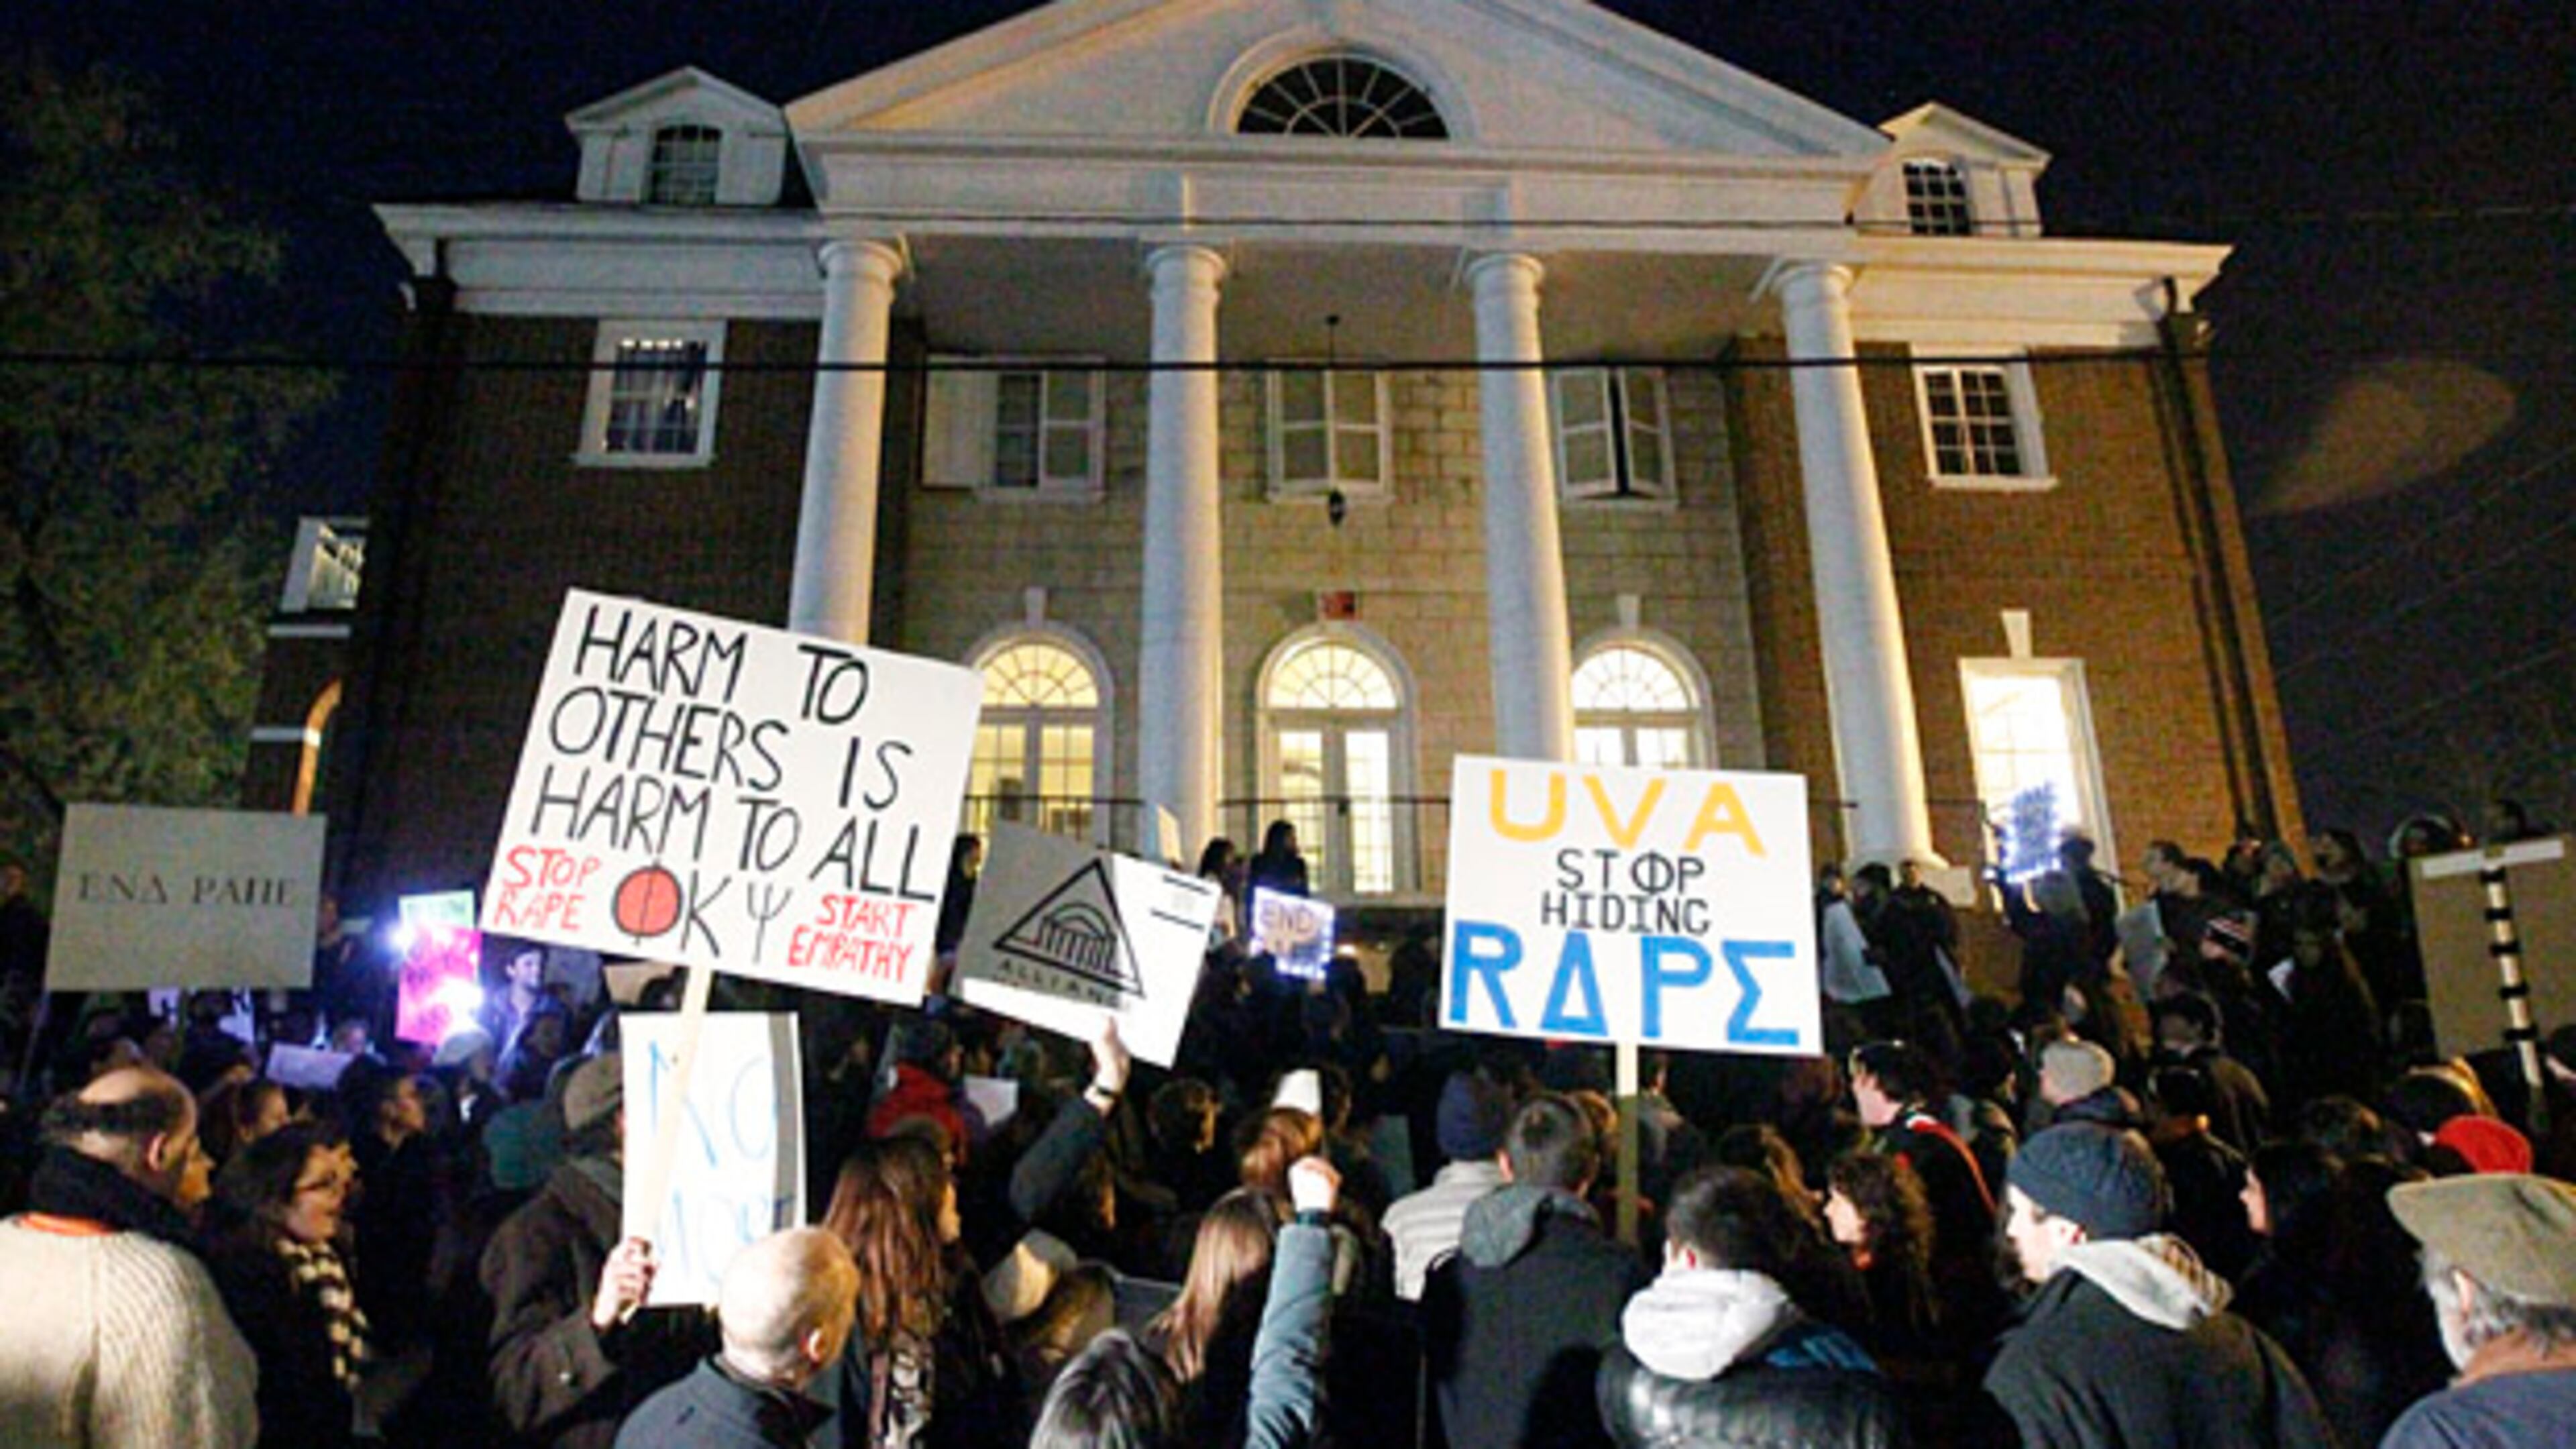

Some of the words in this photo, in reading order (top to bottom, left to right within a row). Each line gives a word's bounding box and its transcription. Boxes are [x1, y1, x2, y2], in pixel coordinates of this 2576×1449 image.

[574, 605, 747, 703] HARM
[798, 643, 869, 724] TO
[548, 686, 790, 792] OTHERS
[839, 737, 913, 811] IS
[531, 764, 710, 859] HARM
[738, 798, 799, 871] TO
[810, 816, 935, 902] ALL
[1488, 768, 1766, 858] UVA
[502, 845, 600, 889] STOP
[492, 886, 585, 931] RAPE
[816, 893, 917, 938] START
[1541, 890, 1712, 936] HIDING
[787, 923, 914, 984] EMPATHY
[996, 956, 1134, 1010] ALLIAN
